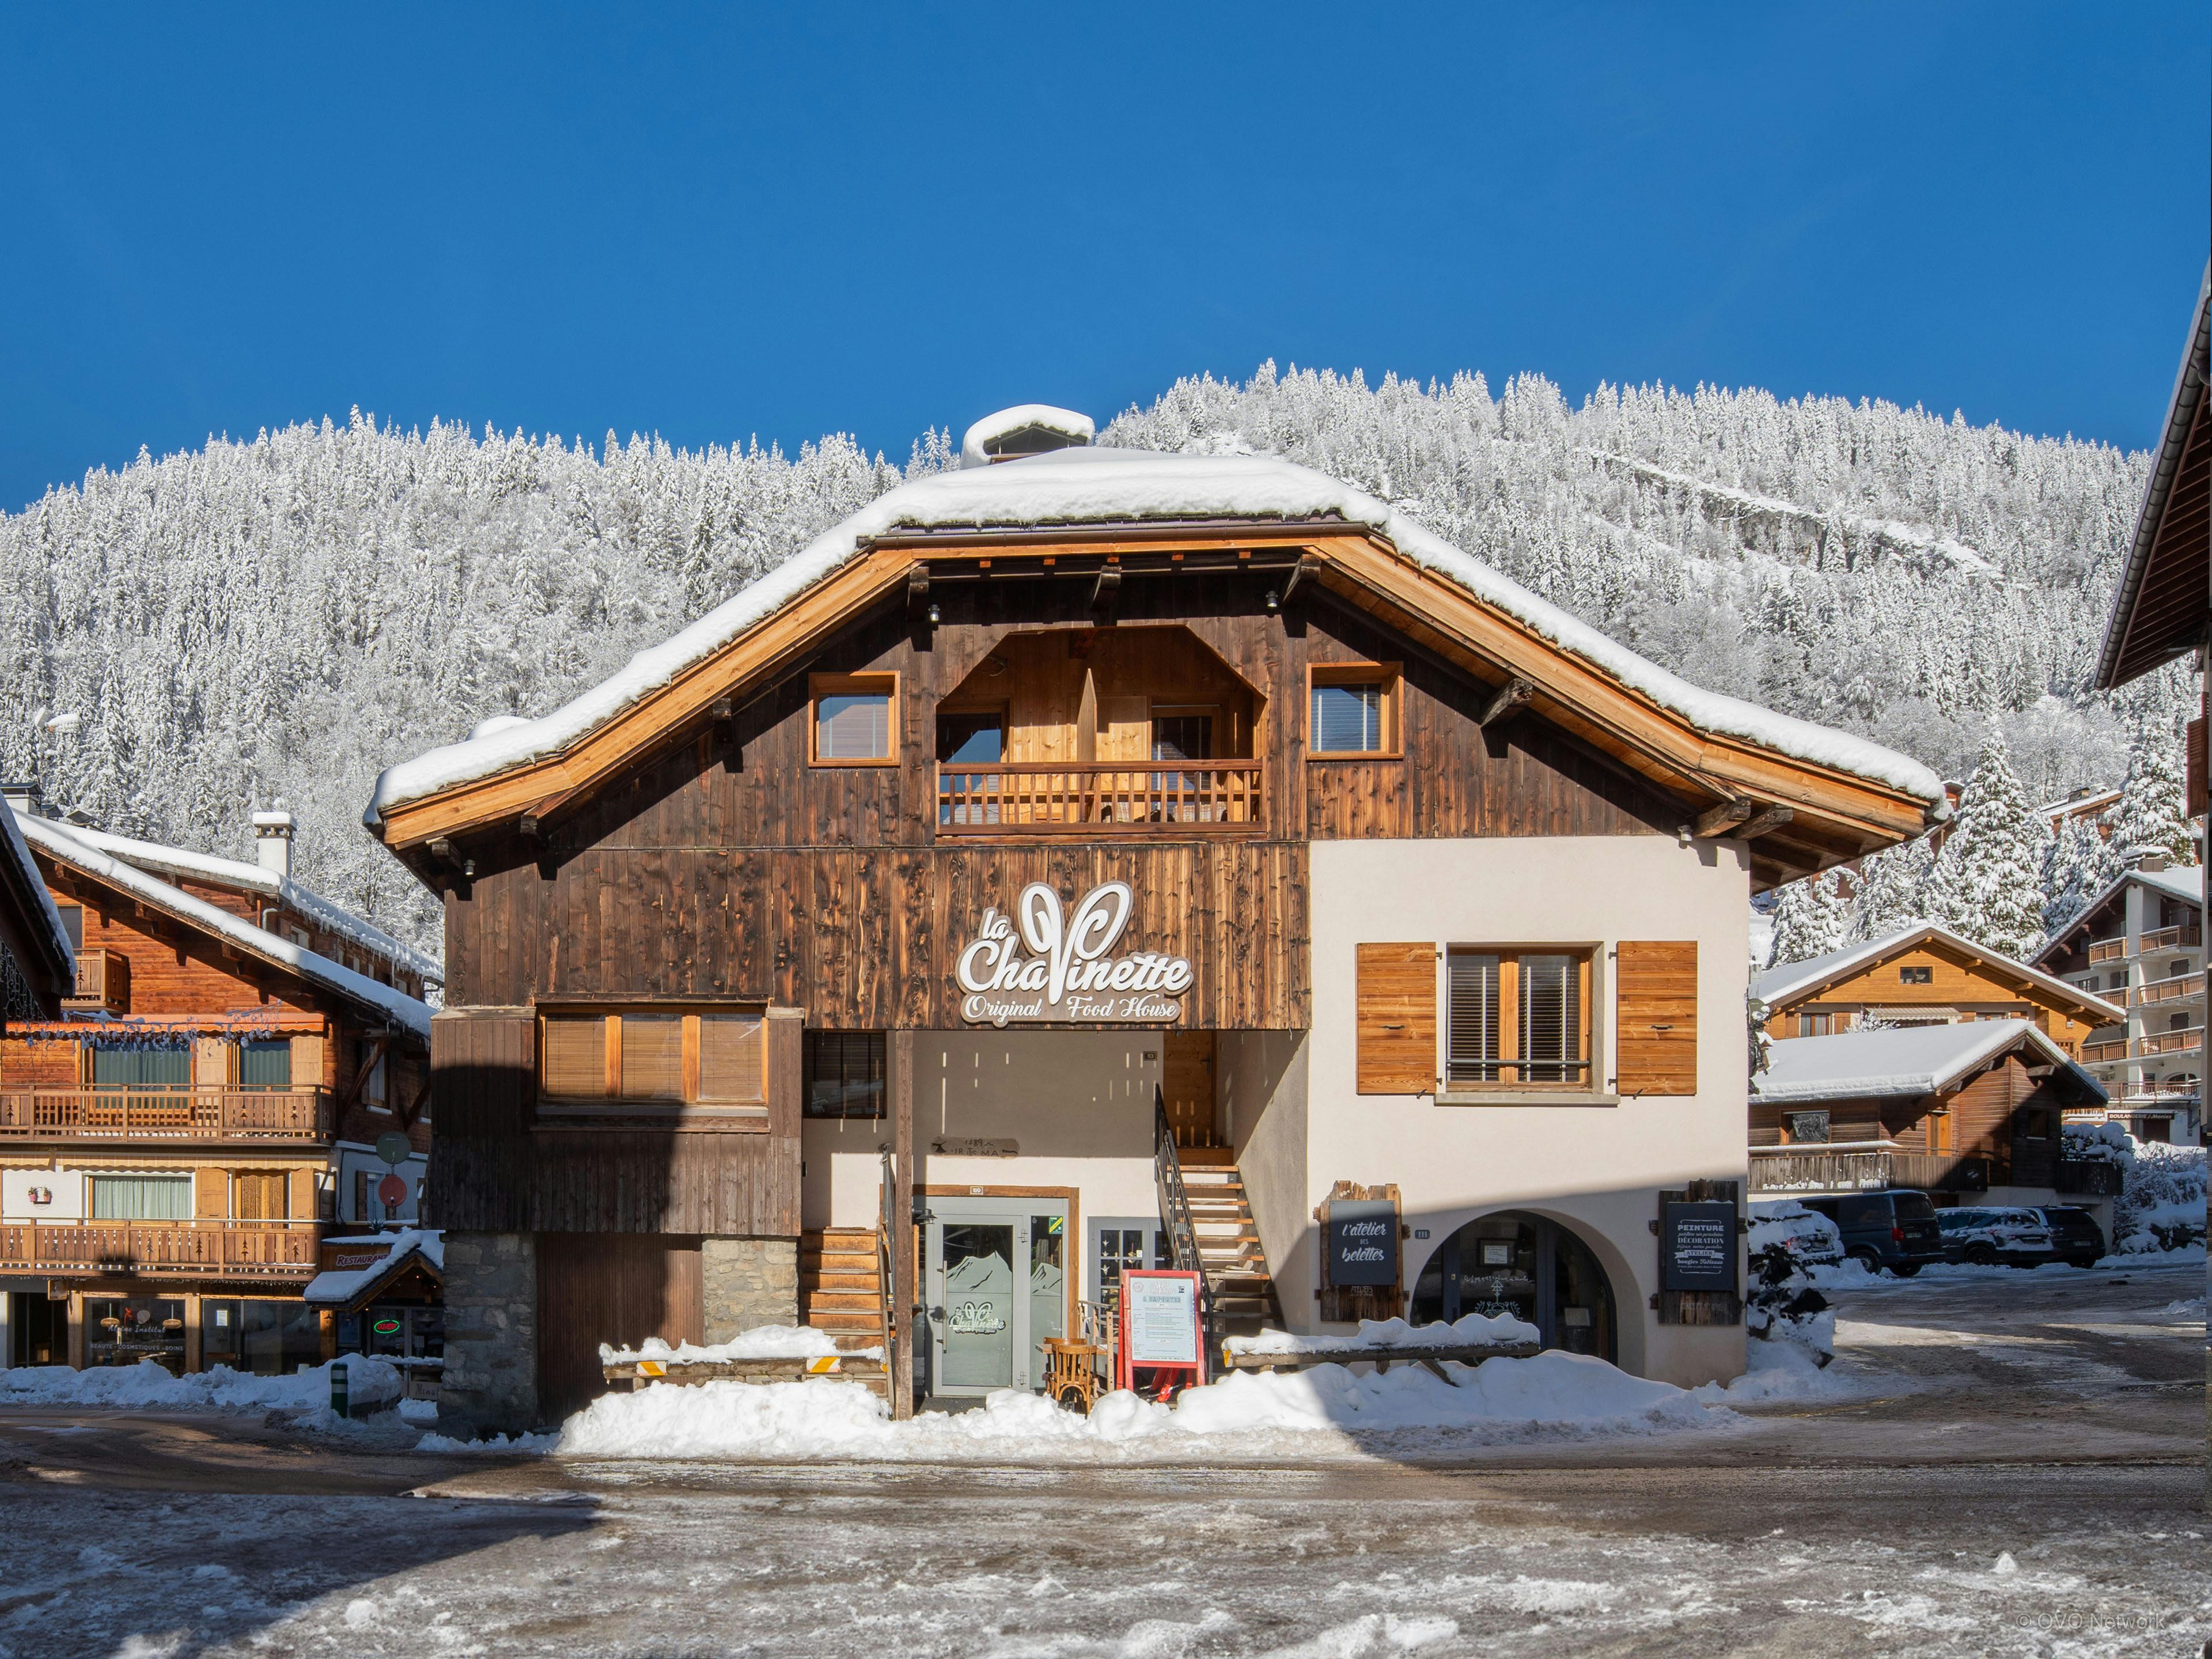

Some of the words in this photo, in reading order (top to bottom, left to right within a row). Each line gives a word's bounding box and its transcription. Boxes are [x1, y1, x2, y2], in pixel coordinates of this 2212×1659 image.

[983, 910, 1009, 940] la
[965, 996, 1041, 1022] Original
[1067, 996, 1114, 1018] Food
[1119, 994, 1177, 1018] House
[1342, 1222, 1387, 1236] l'atelier
[1342, 1247, 1385, 1263] belettes
[134, 1324, 166, 1334] Institut
